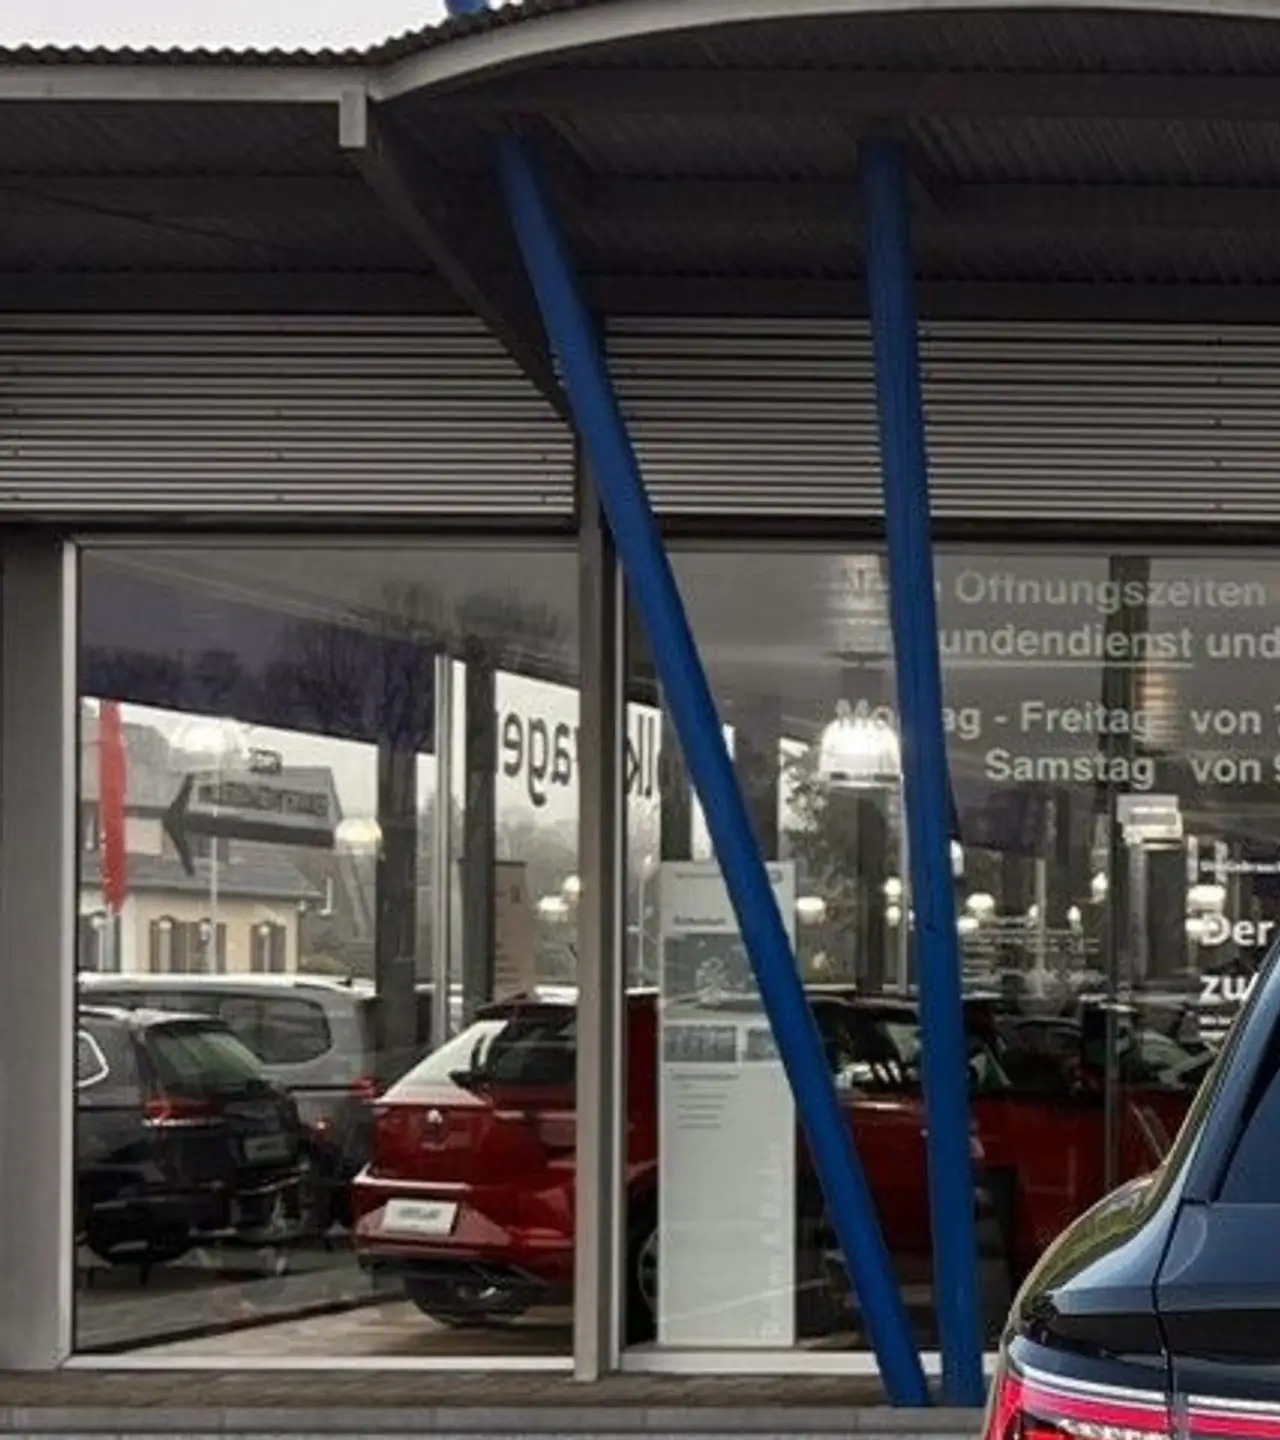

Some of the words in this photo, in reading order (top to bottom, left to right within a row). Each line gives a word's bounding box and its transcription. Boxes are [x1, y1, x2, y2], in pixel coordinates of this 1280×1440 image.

[938, 624, 1193, 658] undendienst
[1021, 700, 1153, 742] Freitag
[1190, 709, 1262, 736] von
[984, 747, 1156, 789] Samstag
[1190, 758, 1262, 784] von
[1200, 913, 1275, 946] Der
